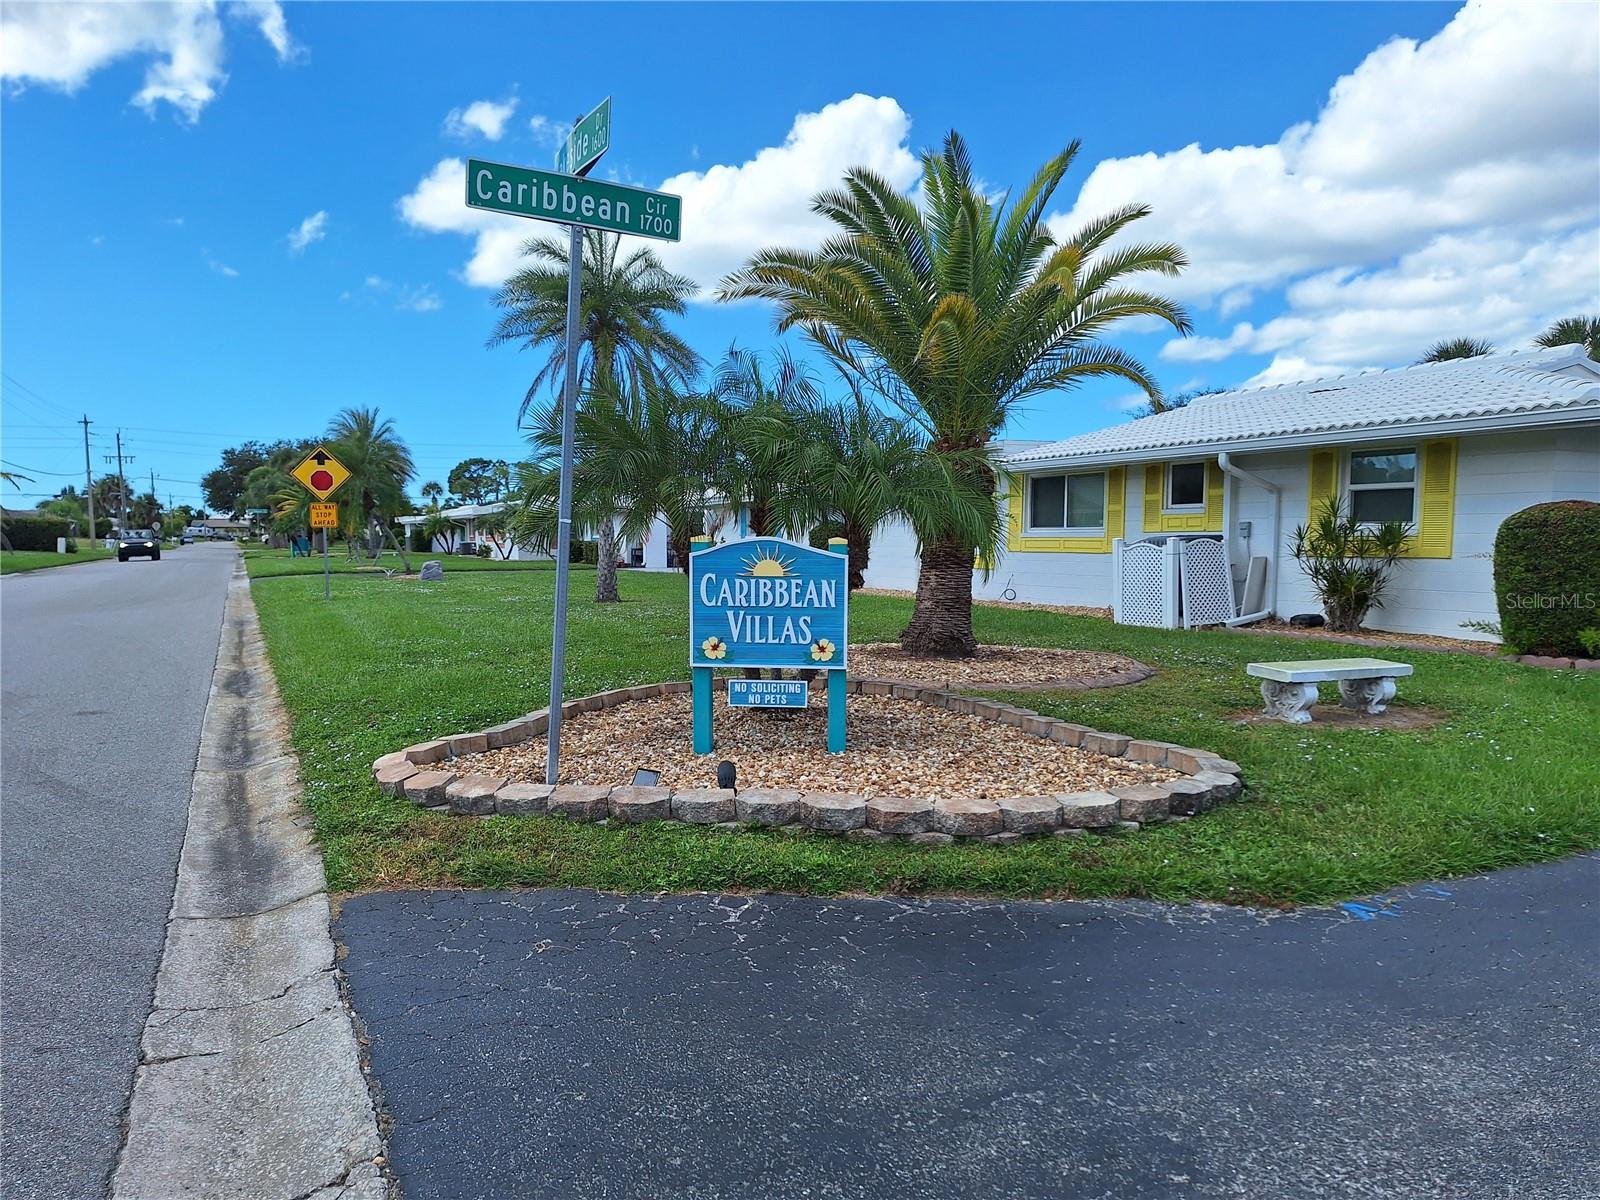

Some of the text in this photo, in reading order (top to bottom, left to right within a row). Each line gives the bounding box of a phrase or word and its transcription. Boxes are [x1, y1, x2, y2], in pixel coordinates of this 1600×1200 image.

[595, 112, 604, 130] Dr
[591, 126, 607, 153] 1600
[476, 169, 630, 224] Caribbean
[646, 197, 668, 216] Cir
[639, 214, 673, 235] 1700
[700, 573, 837, 608] CARIBBEAN
[726, 610, 813, 645] VILLAS
[734, 682, 801, 693] NO SOLICITING
[748, 694, 787, 704] NO PETS
